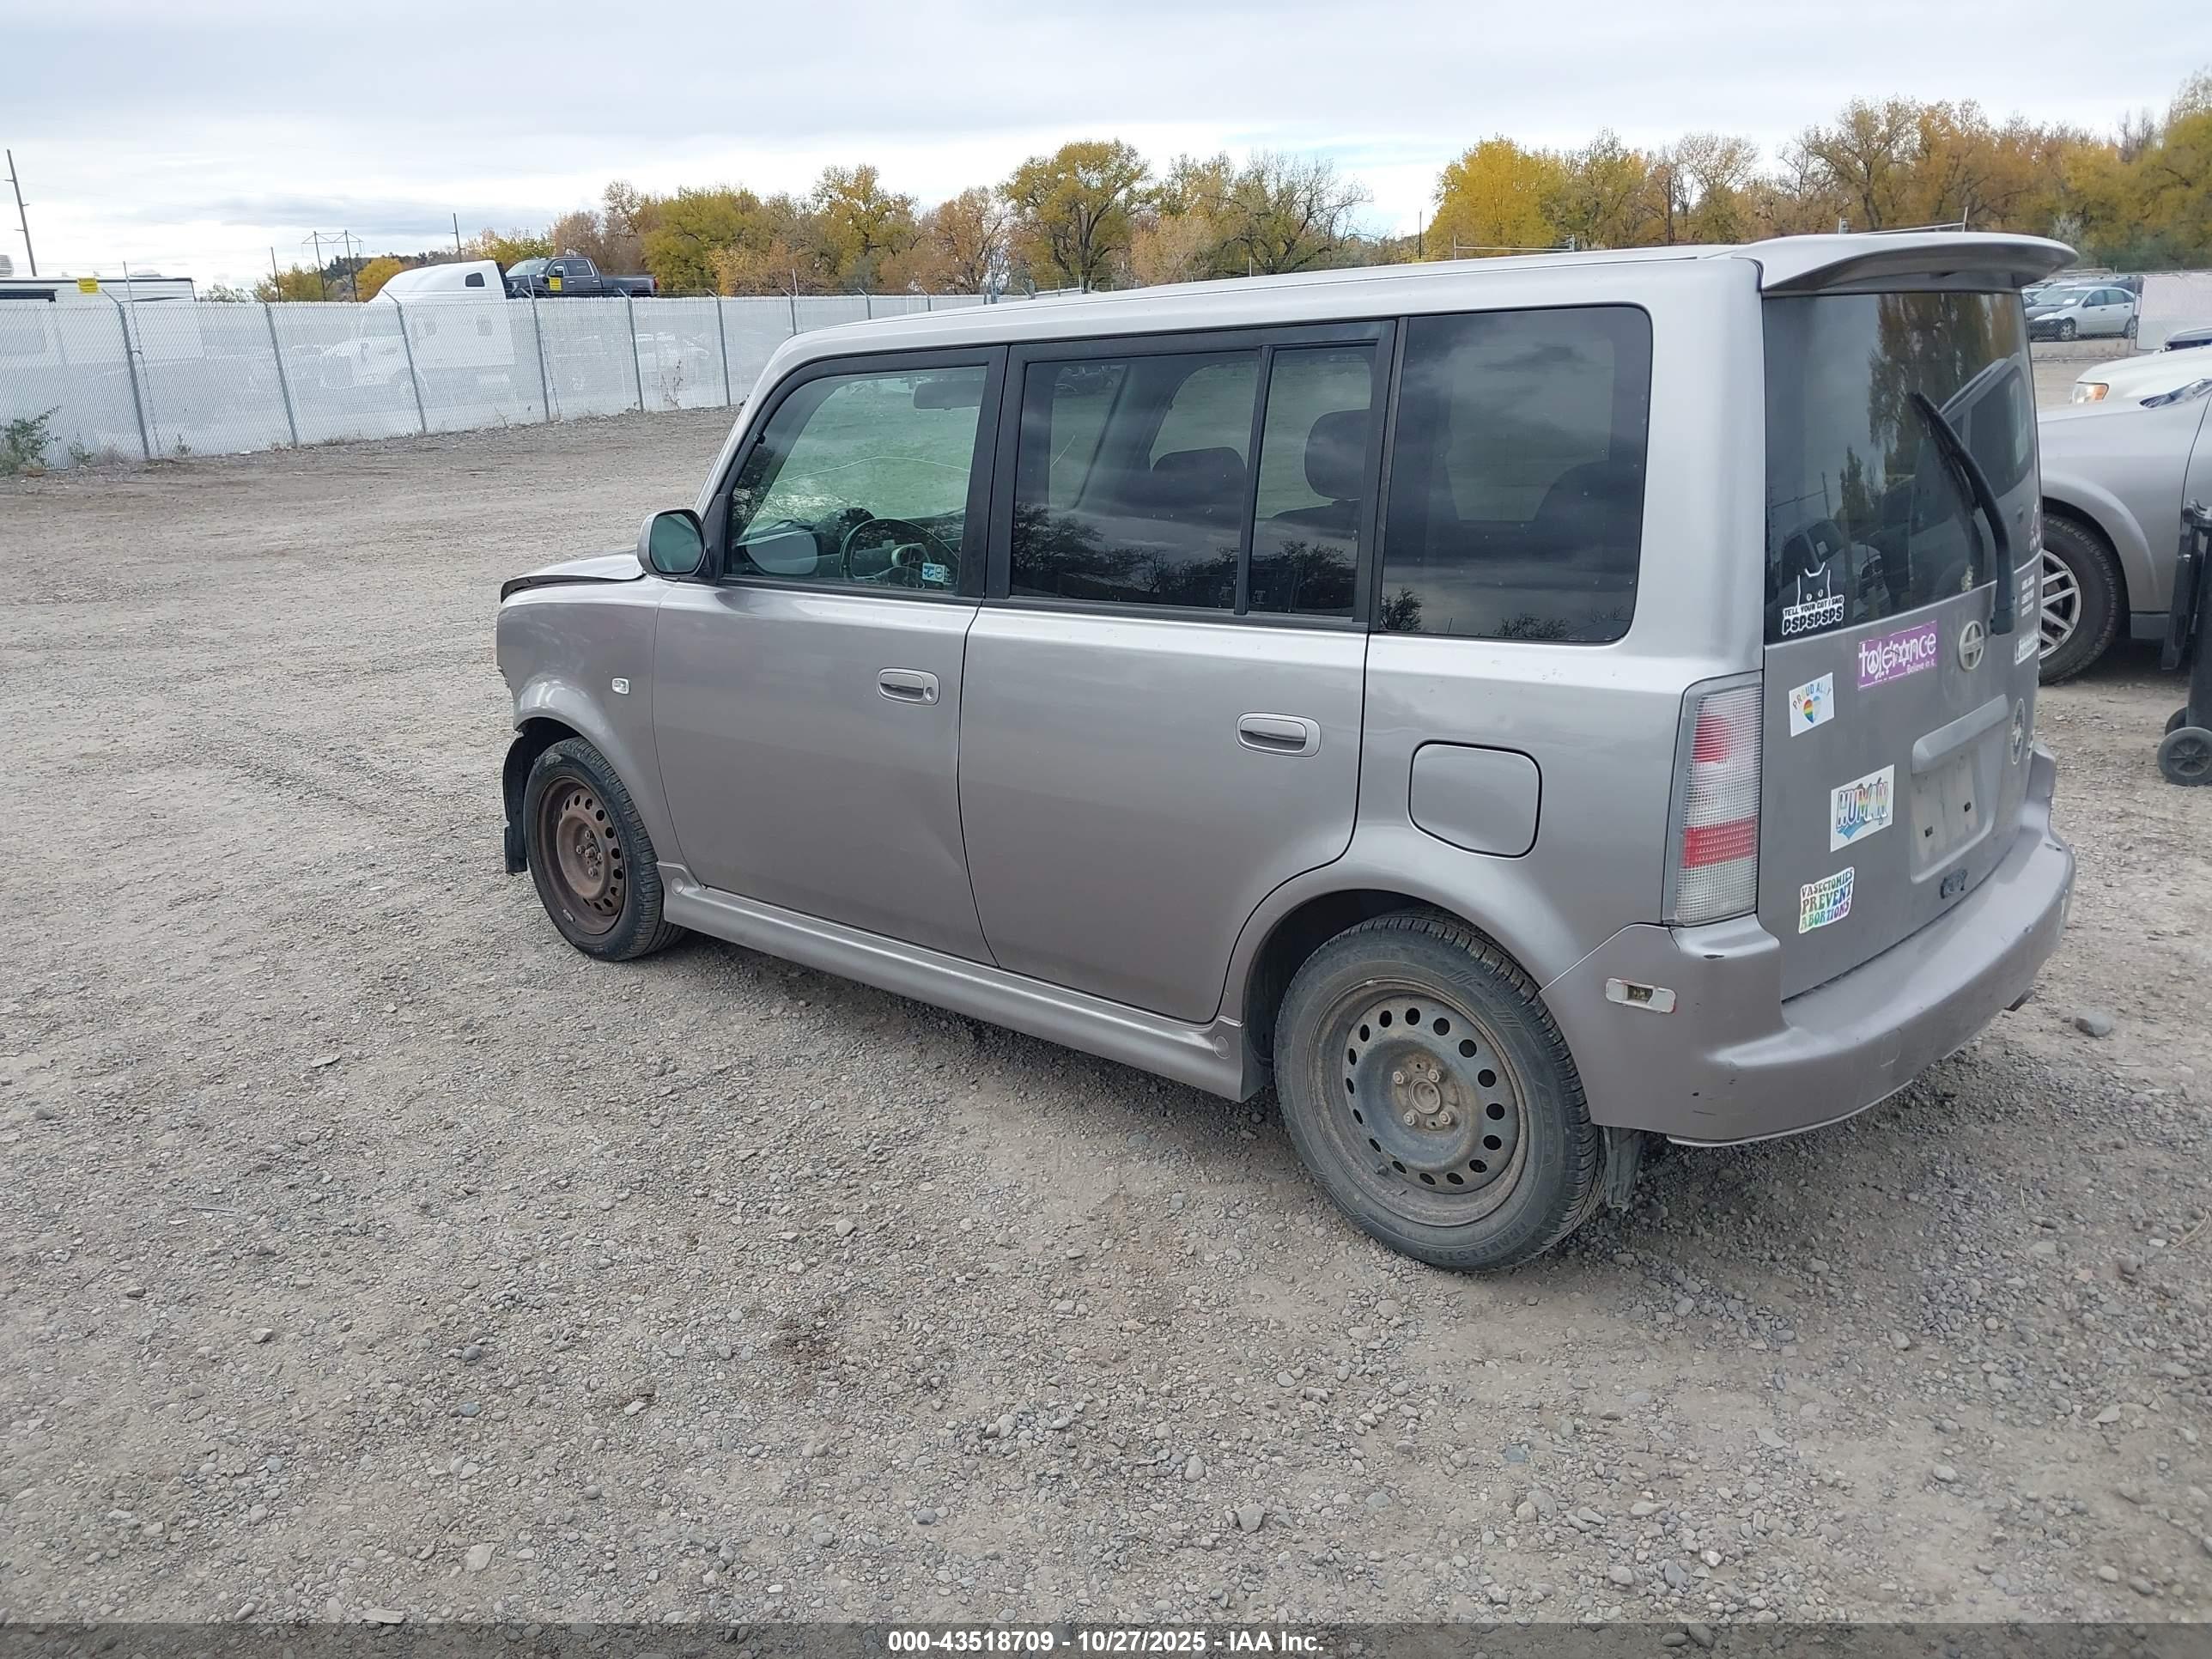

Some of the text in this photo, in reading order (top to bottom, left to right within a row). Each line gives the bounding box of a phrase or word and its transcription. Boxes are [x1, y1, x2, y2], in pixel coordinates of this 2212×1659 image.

[1784, 607, 1799, 617] TELL
[1801, 603, 1815, 612] YOUR
[1817, 600, 1828, 609] CAT
[1832, 597, 1844, 605] SAID
[1784, 605, 1843, 633] PSPSPSPS
[1802, 868, 1853, 897] VASECTOMIES
[1802, 880, 1852, 915] PREVENT
[1800, 897, 1850, 931] ABORTIONS
